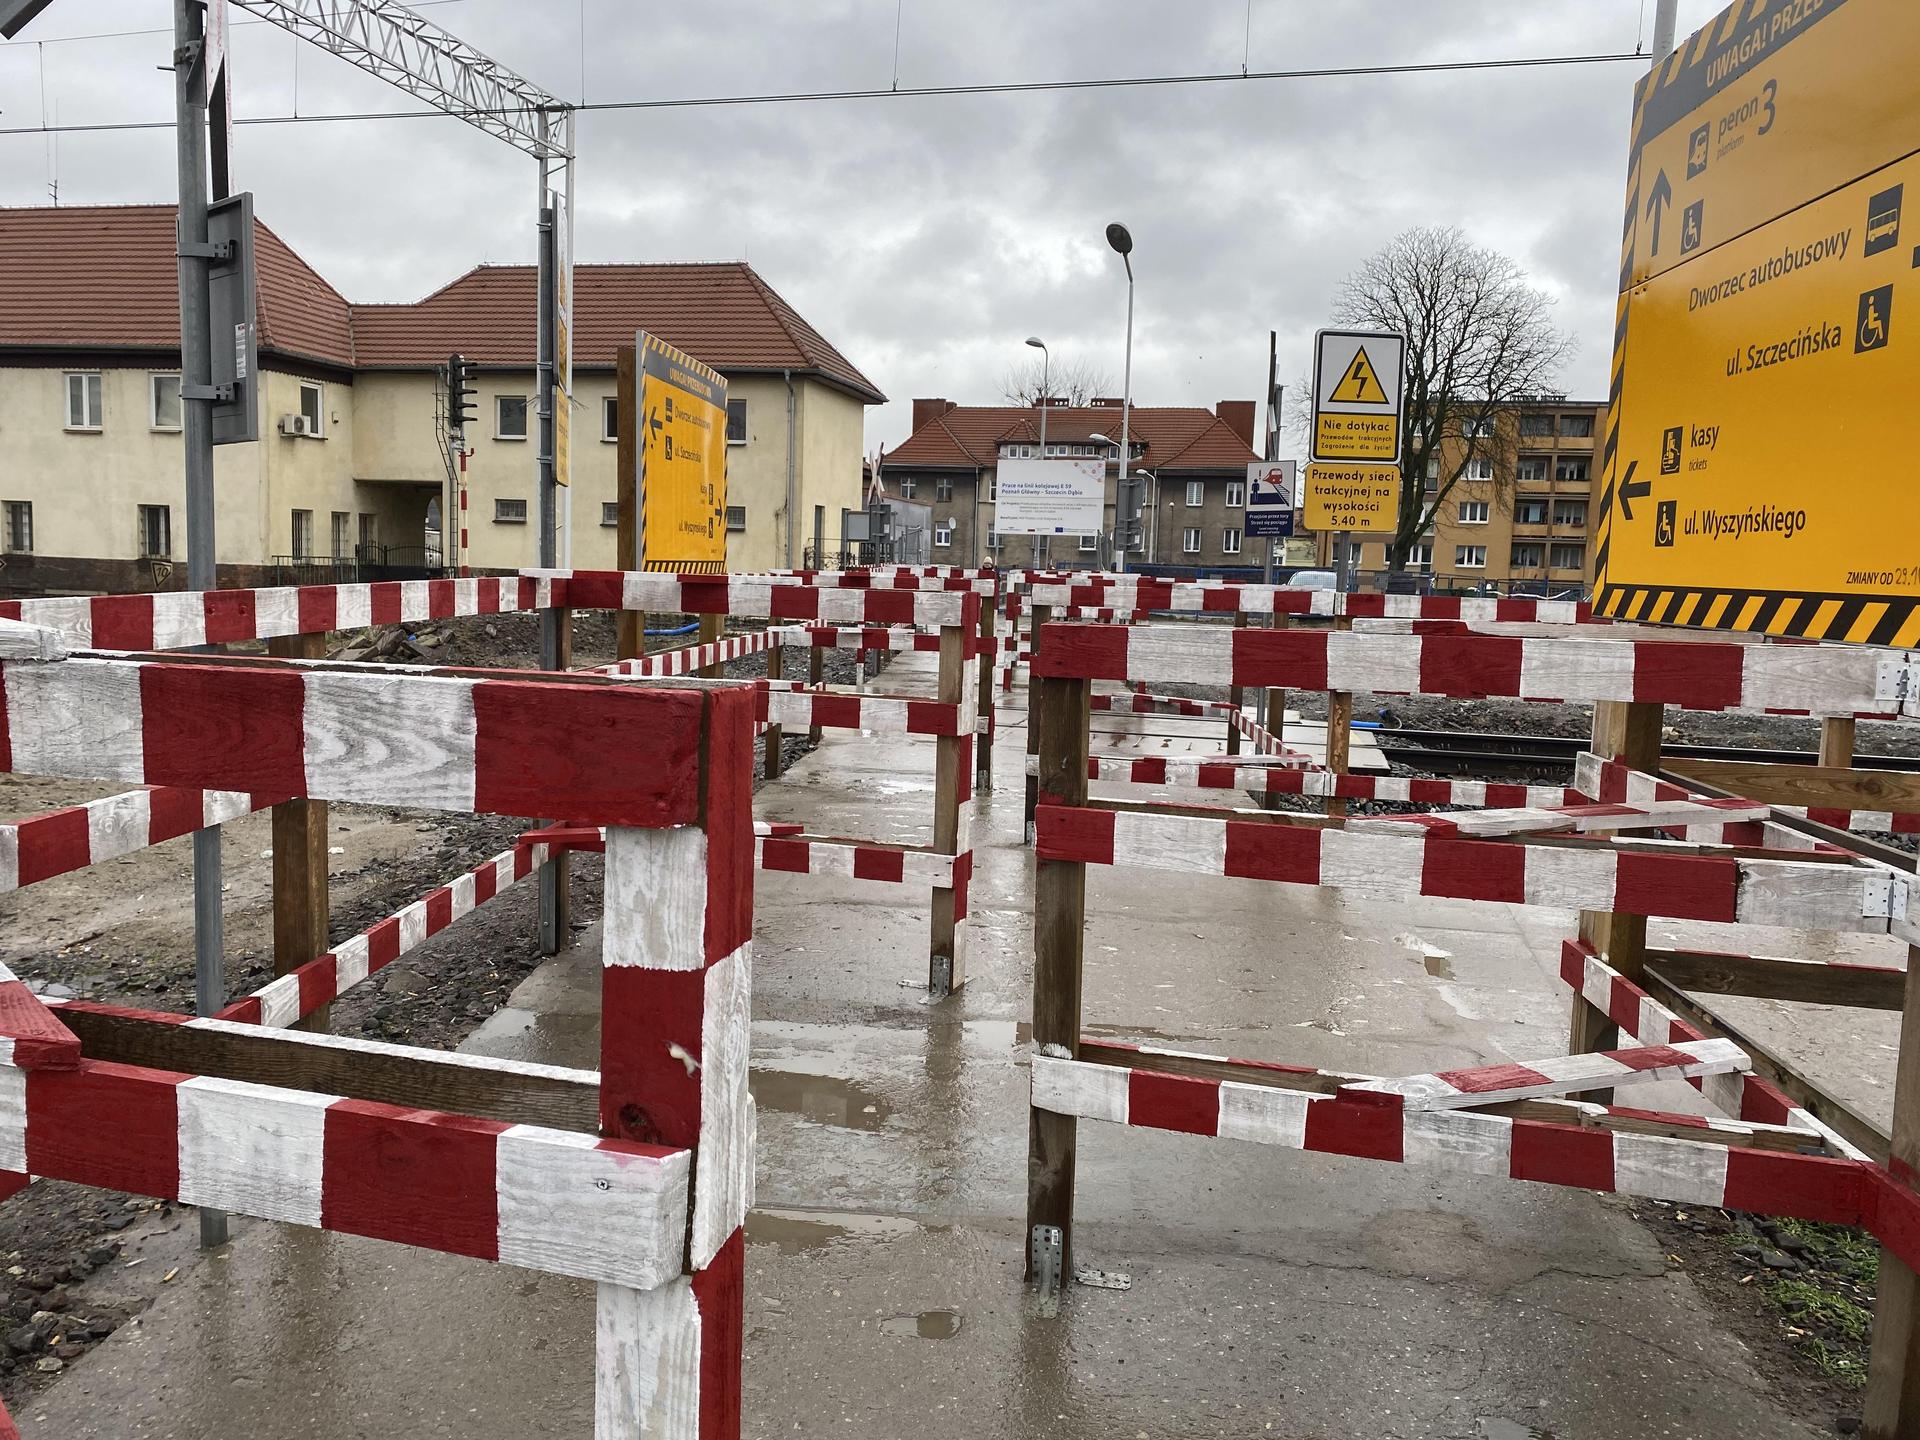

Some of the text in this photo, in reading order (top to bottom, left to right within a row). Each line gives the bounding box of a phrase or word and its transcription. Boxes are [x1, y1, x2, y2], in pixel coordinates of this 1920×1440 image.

[1706, 22, 1768, 88] UWAGA!
[1718, 79, 1777, 144] peron 3
[1689, 228, 1852, 312] Dworzec autobusowy
[1726, 321, 1841, 376] ul. Szczecińska
[1324, 419, 1390, 433] Nie dotykać
[1359, 435, 1392, 443] trakcyjnych
[1690, 423, 1720, 451] kasy
[1688, 458, 1707, 471] tickets
[1312, 469, 1395, 484] Przewody sieci
[1314, 485, 1390, 499] trakcyjnej na
[1323, 501, 1380, 514] wysokości
[1331, 515, 1356, 527] 5,40
[1684, 505, 1806, 541] ul. Wyszyńskiego
[1846, 571, 1879, 585] ZMIANY
[1880, 572, 1894, 585] OD
